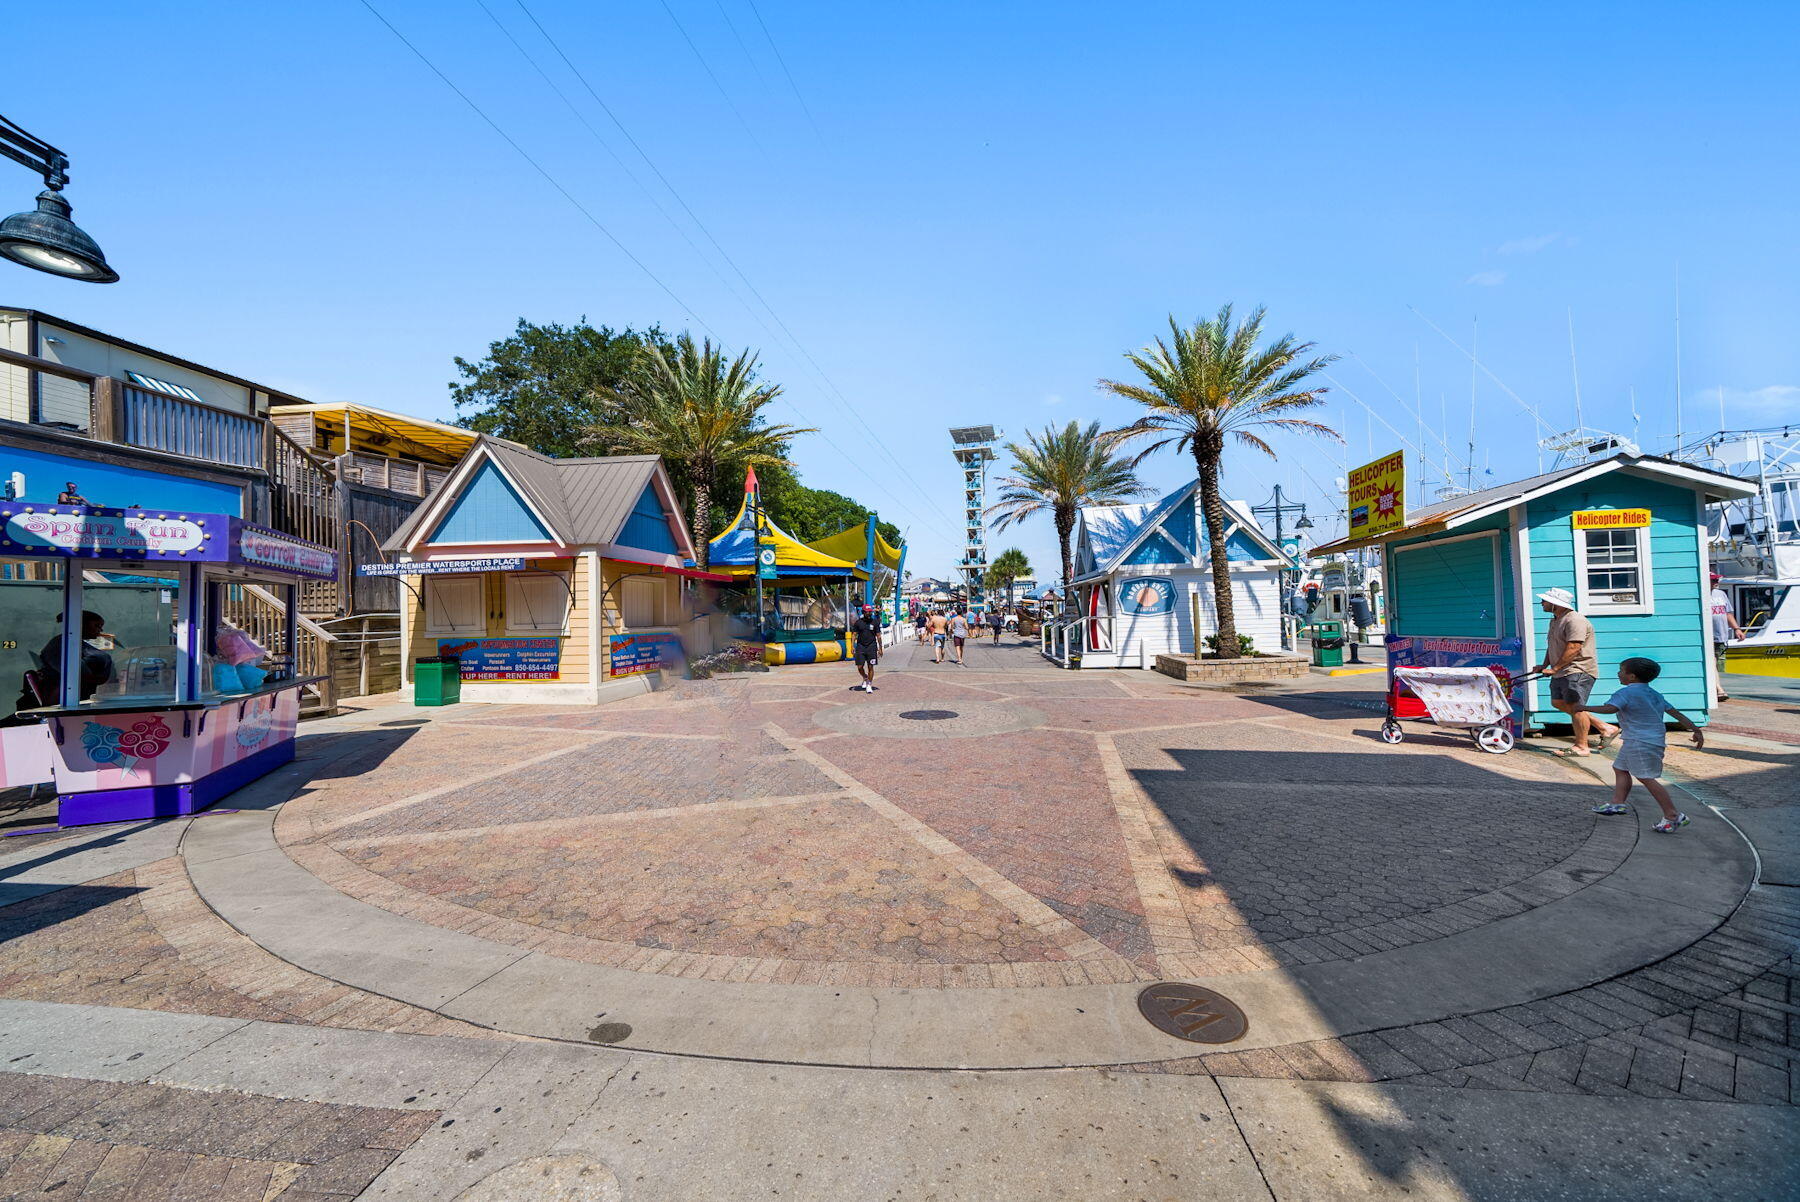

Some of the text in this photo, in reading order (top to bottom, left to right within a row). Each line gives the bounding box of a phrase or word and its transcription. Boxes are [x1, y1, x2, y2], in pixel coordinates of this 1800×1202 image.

[1349, 455, 1403, 488] HELICOPTER
[1349, 482, 1377, 504] TOURS
[1379, 492, 1394, 503] BOOK
[1380, 501, 1394, 511] HERE
[1577, 512, 1647, 526] Helicopter Rides
[23, 515, 188, 538] Spun Fun
[61, 534, 163, 548] Cotton Candy
[254, 536, 296, 564] COTTON
[361, 558, 520, 571] DESTINS PREMIER WATERSPORTS PLACE
[3, 640, 17, 649] 29
